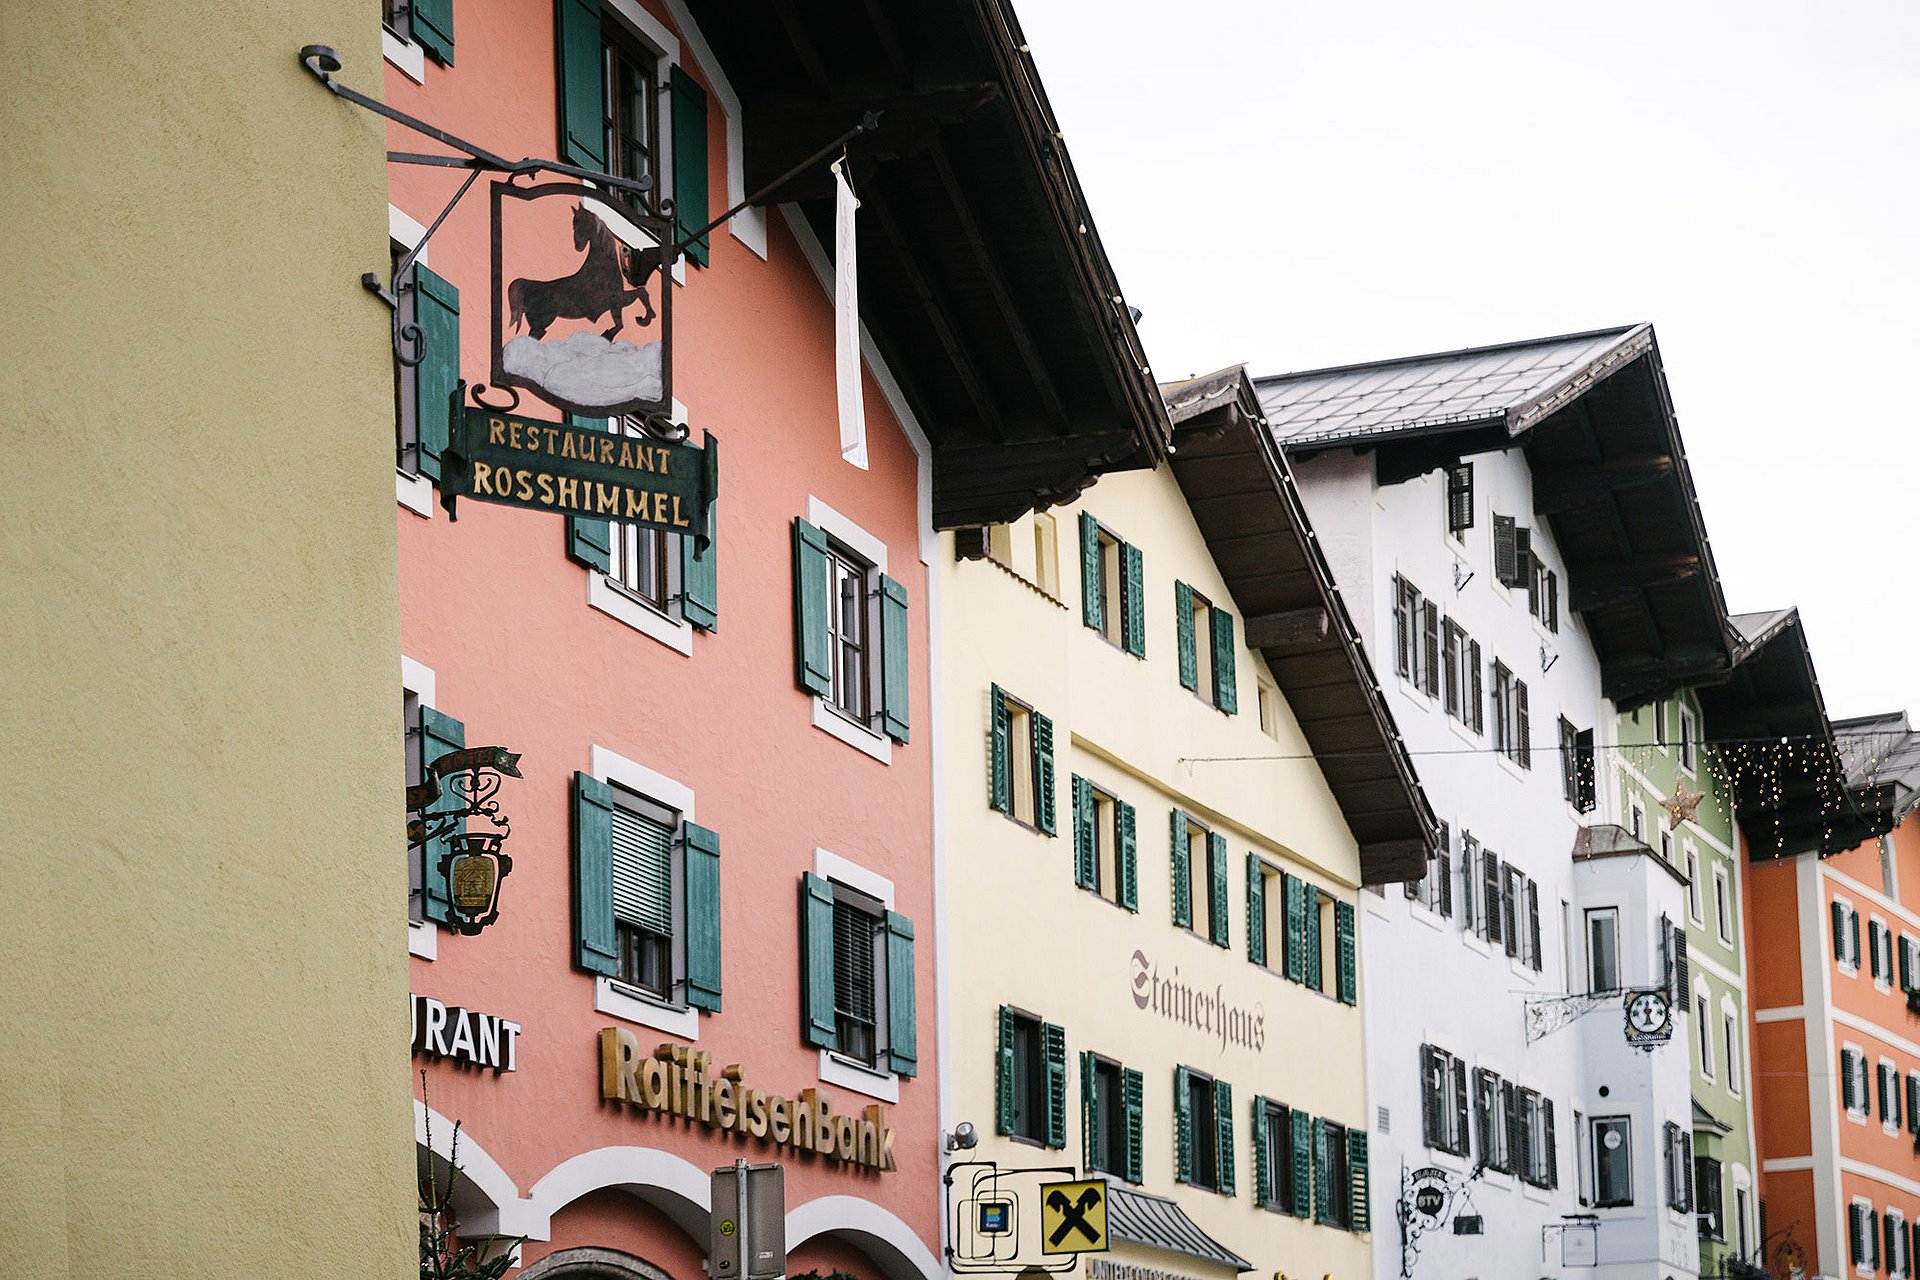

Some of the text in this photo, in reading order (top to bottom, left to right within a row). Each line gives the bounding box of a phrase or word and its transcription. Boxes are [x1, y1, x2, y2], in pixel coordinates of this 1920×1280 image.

[488, 417, 672, 475] RESTAURANT
[473, 461, 690, 528] ROSSHIMMEL
[1130, 949, 1265, 1057] Stainerhaus
[602, 1026, 898, 1172] RaiffeisenBank
